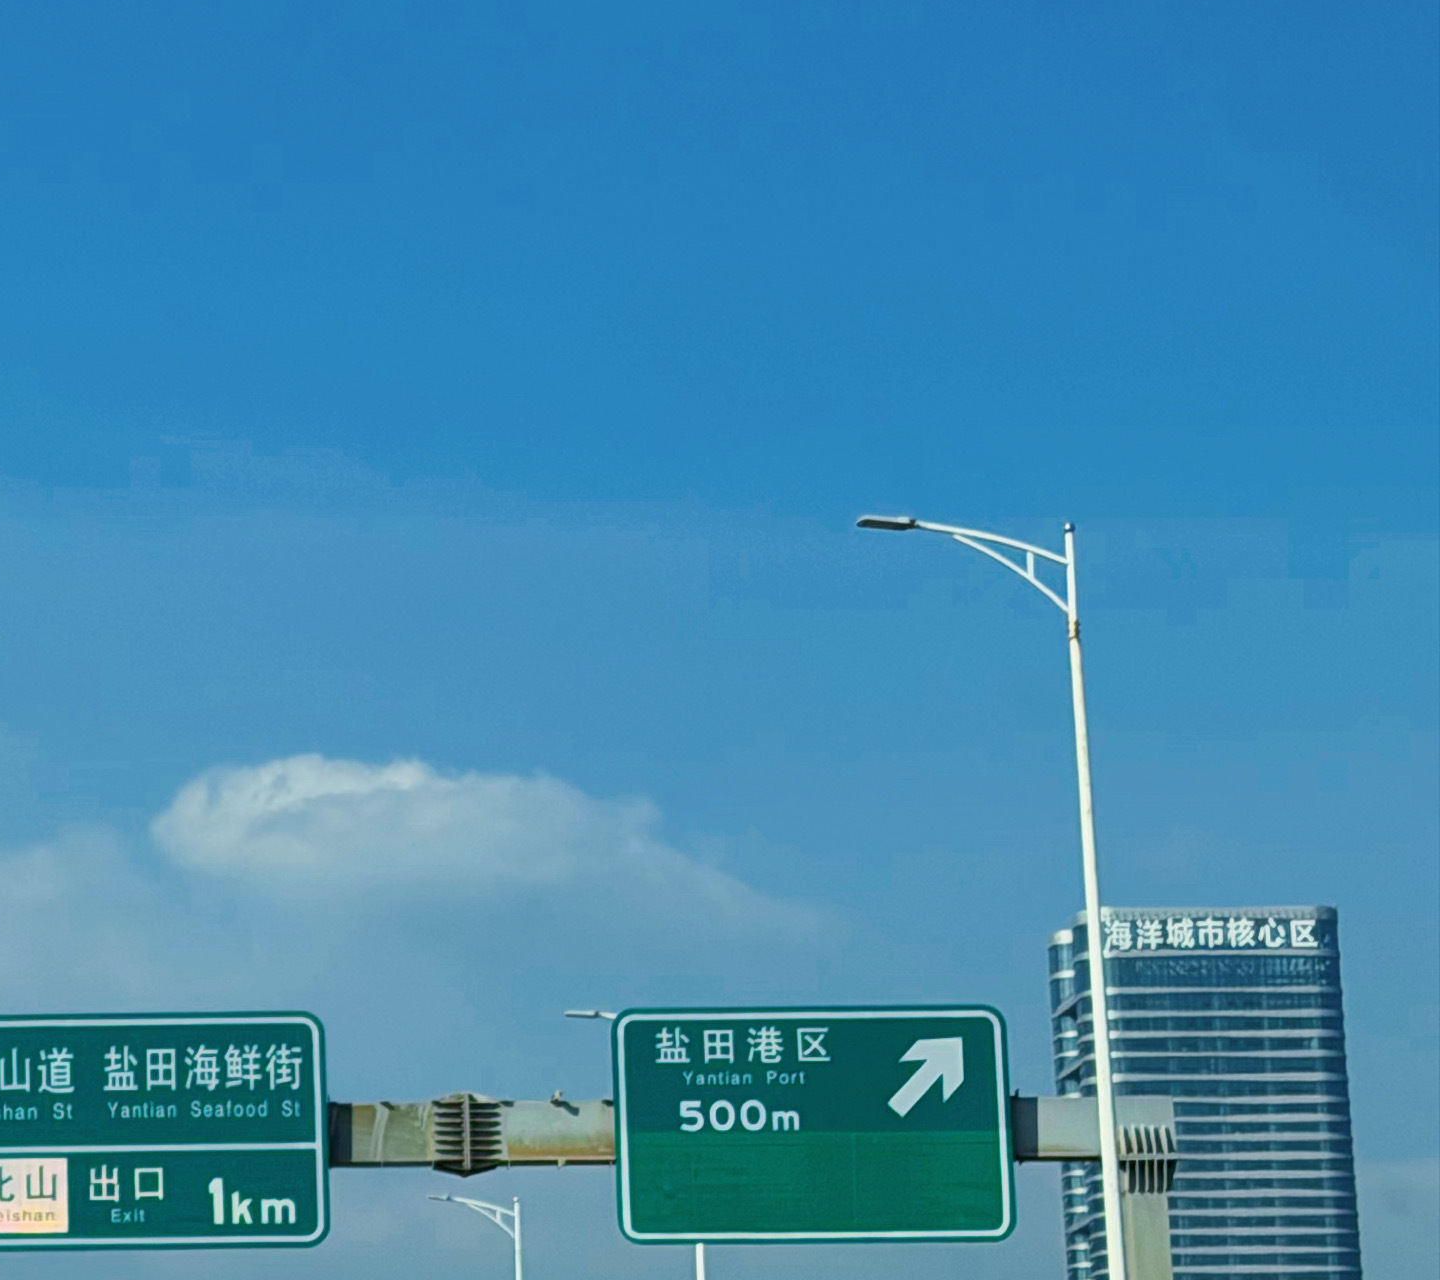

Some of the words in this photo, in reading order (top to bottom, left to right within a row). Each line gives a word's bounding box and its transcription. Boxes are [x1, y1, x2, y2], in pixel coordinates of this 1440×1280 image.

[1104, 917, 1319, 951] 海洋城市核心区
[655, 1026, 831, 1064] 盐田港区
[103, 1043, 302, 1092] 盐田海鲜街
[682, 1070, 752, 1086] Yantian
[766, 1070, 806, 1085] Port
[53, 1103, 73, 1120] St
[108, 1102, 177, 1119] Yantian
[190, 1100, 267, 1118] Seafood
[281, 1099, 300, 1117] St
[679, 1100, 800, 1132] 500m
[89, 1164, 164, 1202] 出口
[111, 1208, 145, 1223] Exit
[208, 1177, 296, 1225] 1km
